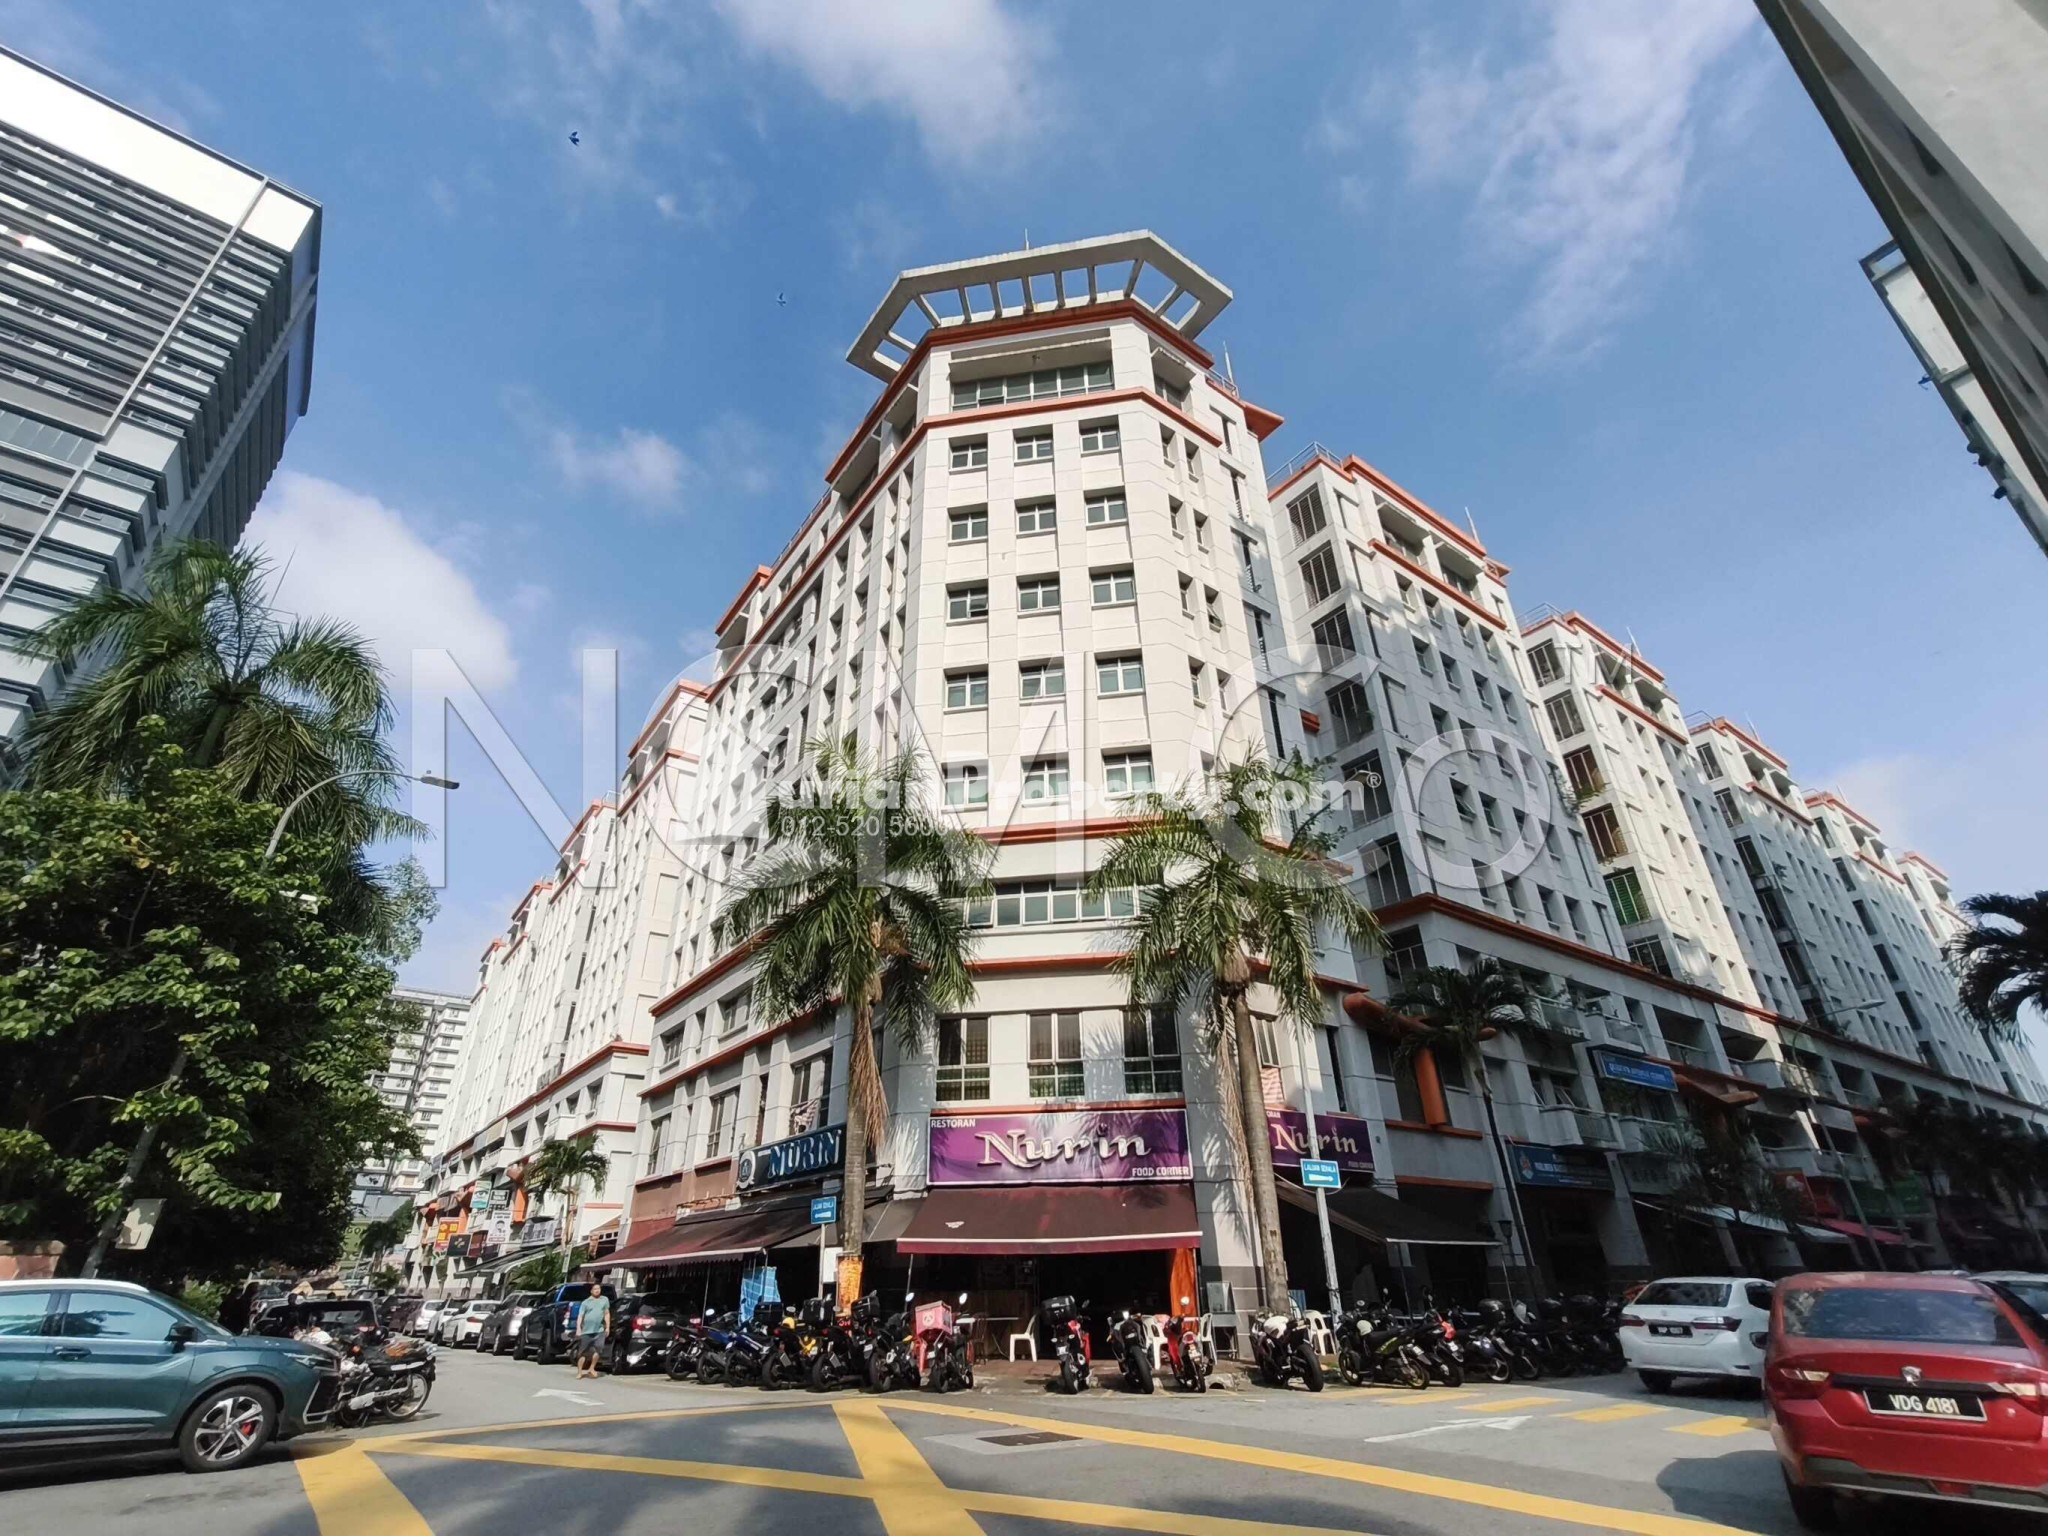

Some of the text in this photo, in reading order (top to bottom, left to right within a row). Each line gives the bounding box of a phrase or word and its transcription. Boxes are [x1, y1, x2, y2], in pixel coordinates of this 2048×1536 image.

[931, 1118, 976, 1129] RESTORAN
[975, 1123, 1151, 1169] Nurin
[1270, 1122, 1359, 1155] Nurin
[767, 1128, 842, 1179] NURIN
[1132, 1166, 1189, 1177] FOOD CORNER
[1889, 1394, 1961, 1415] VDG 4181
